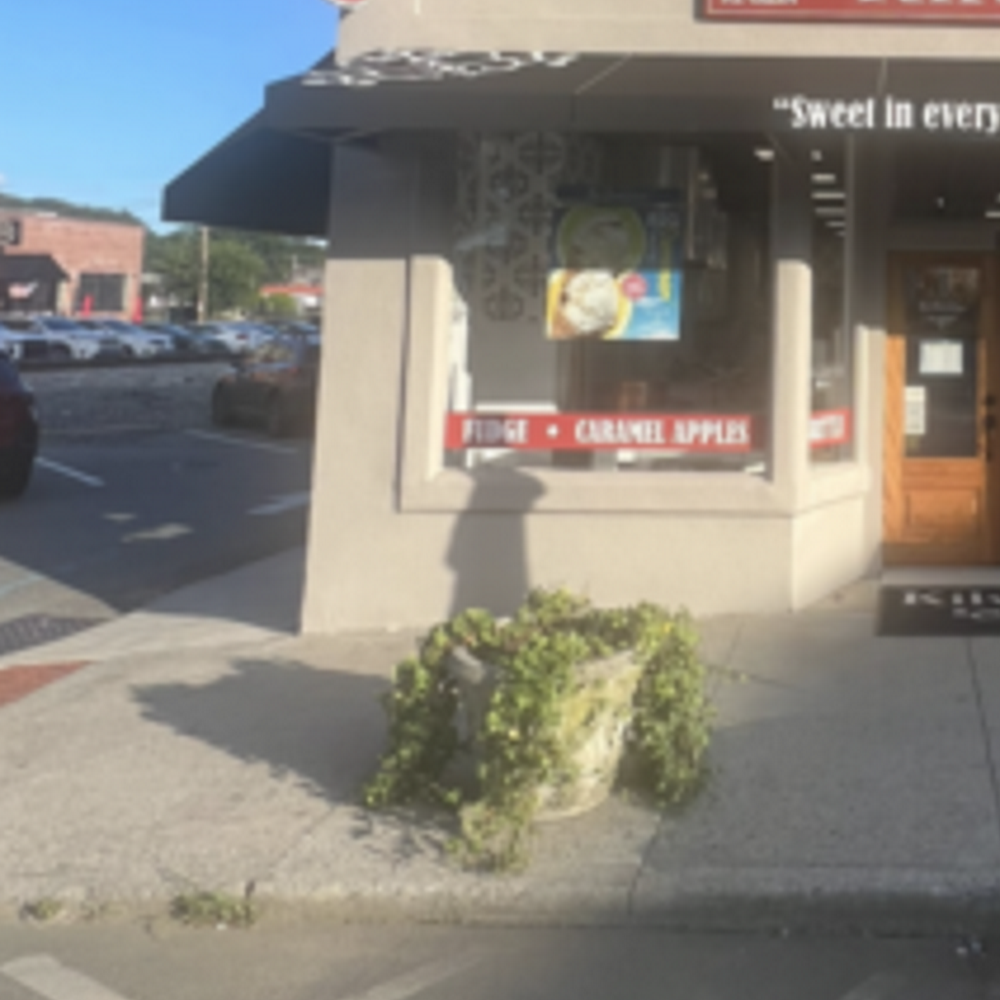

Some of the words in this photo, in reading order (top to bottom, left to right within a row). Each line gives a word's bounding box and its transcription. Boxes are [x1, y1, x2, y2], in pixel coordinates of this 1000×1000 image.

[886, 95, 913, 129] in
[574, 419, 665, 444] CARAMEL
[672, 419, 750, 445] APPLES
